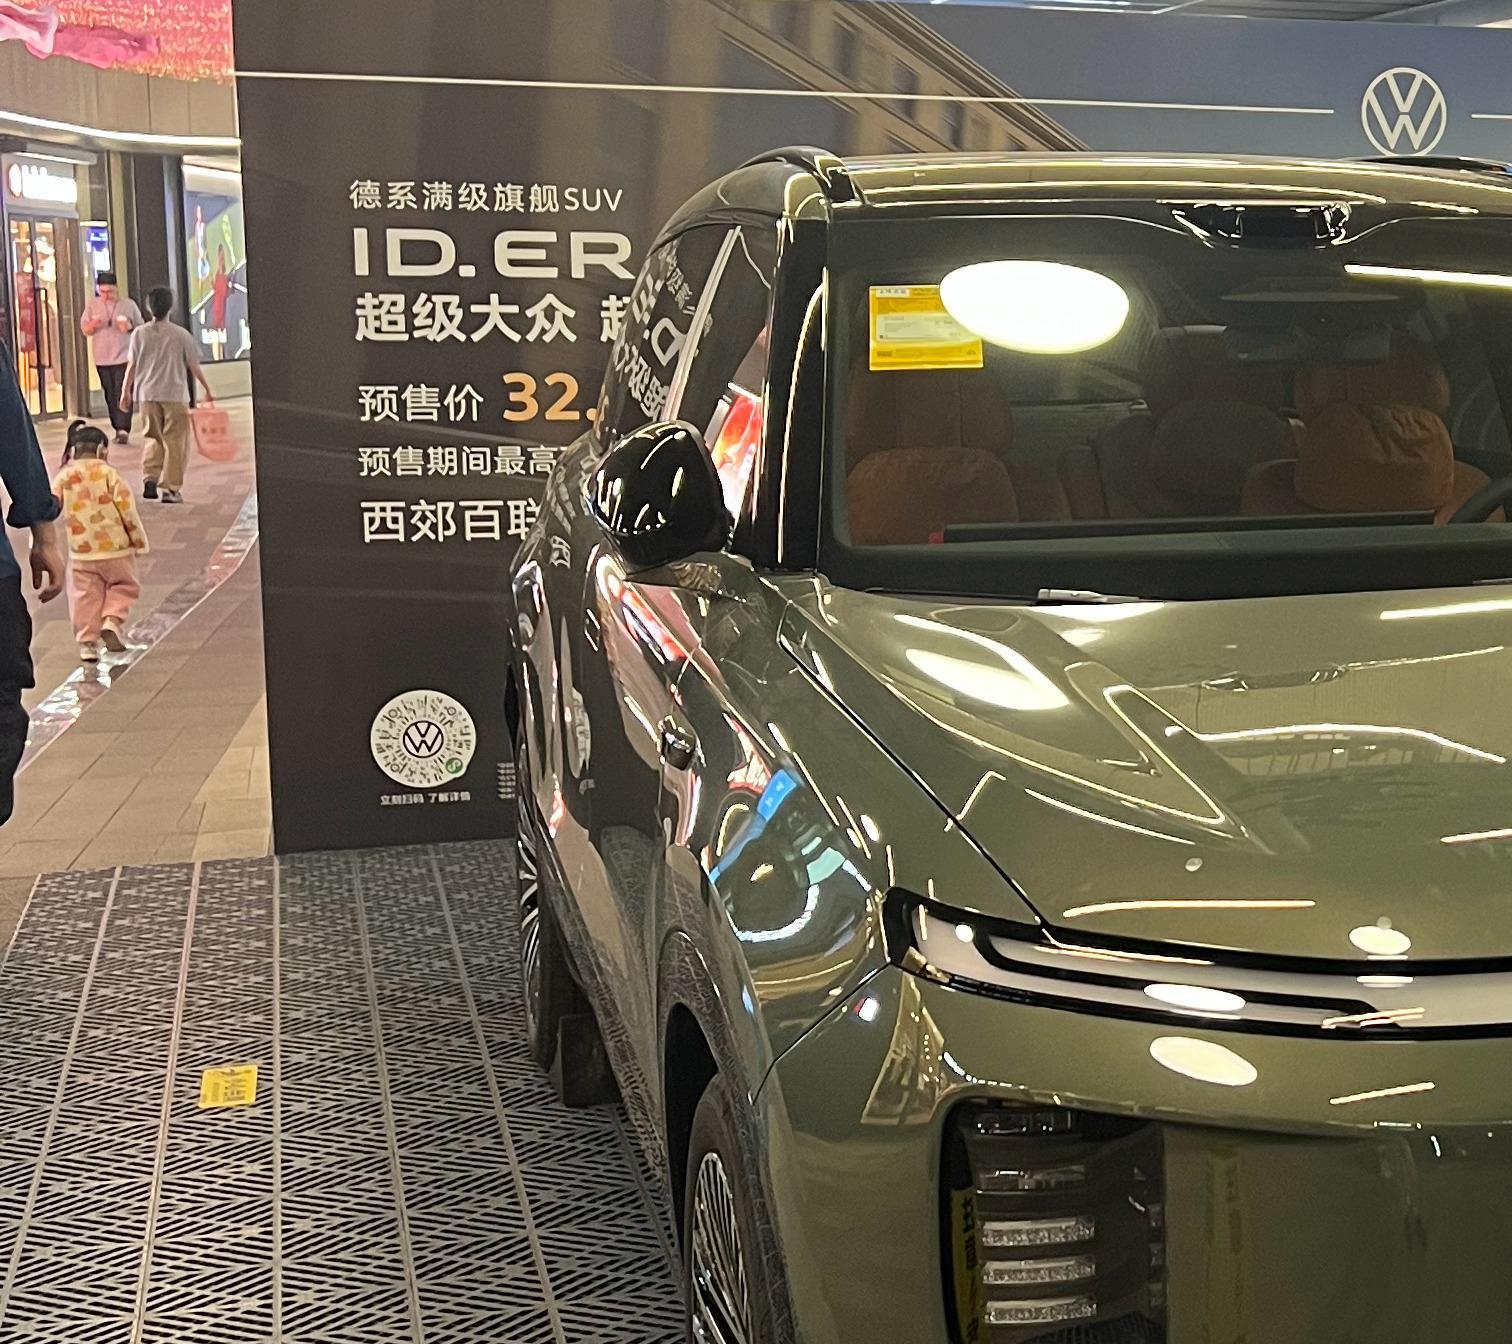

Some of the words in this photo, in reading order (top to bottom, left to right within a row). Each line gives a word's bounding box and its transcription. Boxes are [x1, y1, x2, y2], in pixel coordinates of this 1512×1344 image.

[350, 179, 623, 213] 德系满级旗舰SUV
[355, 292, 577, 343] 超级大众
[358, 384, 484, 422] 预售价
[358, 445, 569, 476] 预售期间最高
